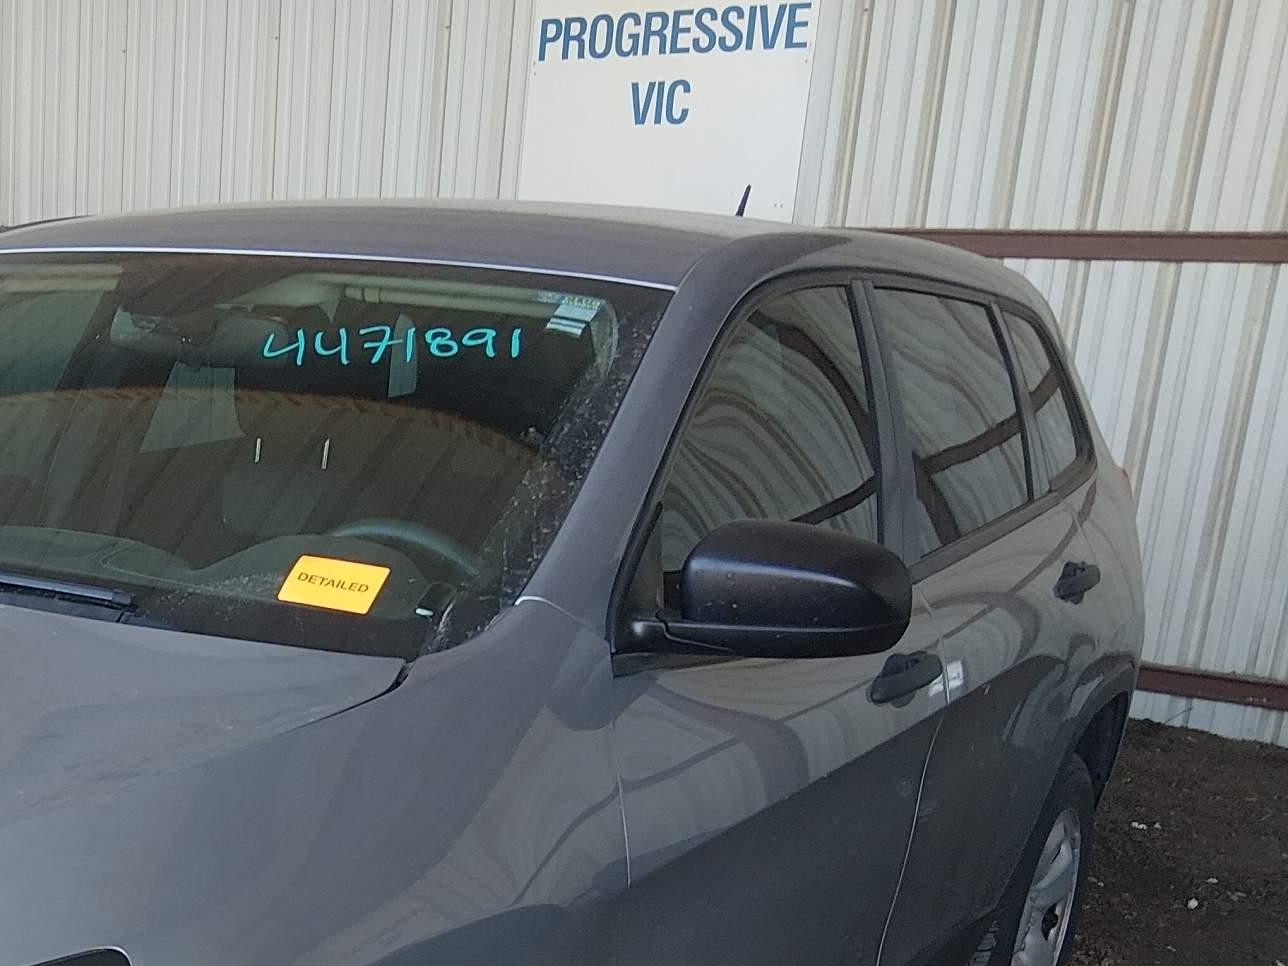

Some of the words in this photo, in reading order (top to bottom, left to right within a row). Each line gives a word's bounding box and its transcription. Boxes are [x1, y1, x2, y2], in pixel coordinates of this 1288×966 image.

[538, 2, 812, 61] PROGRESSIVE
[631, 79, 692, 126] VIC
[262, 326, 521, 366] 4471891
[297, 572, 369, 593] DETAILED
